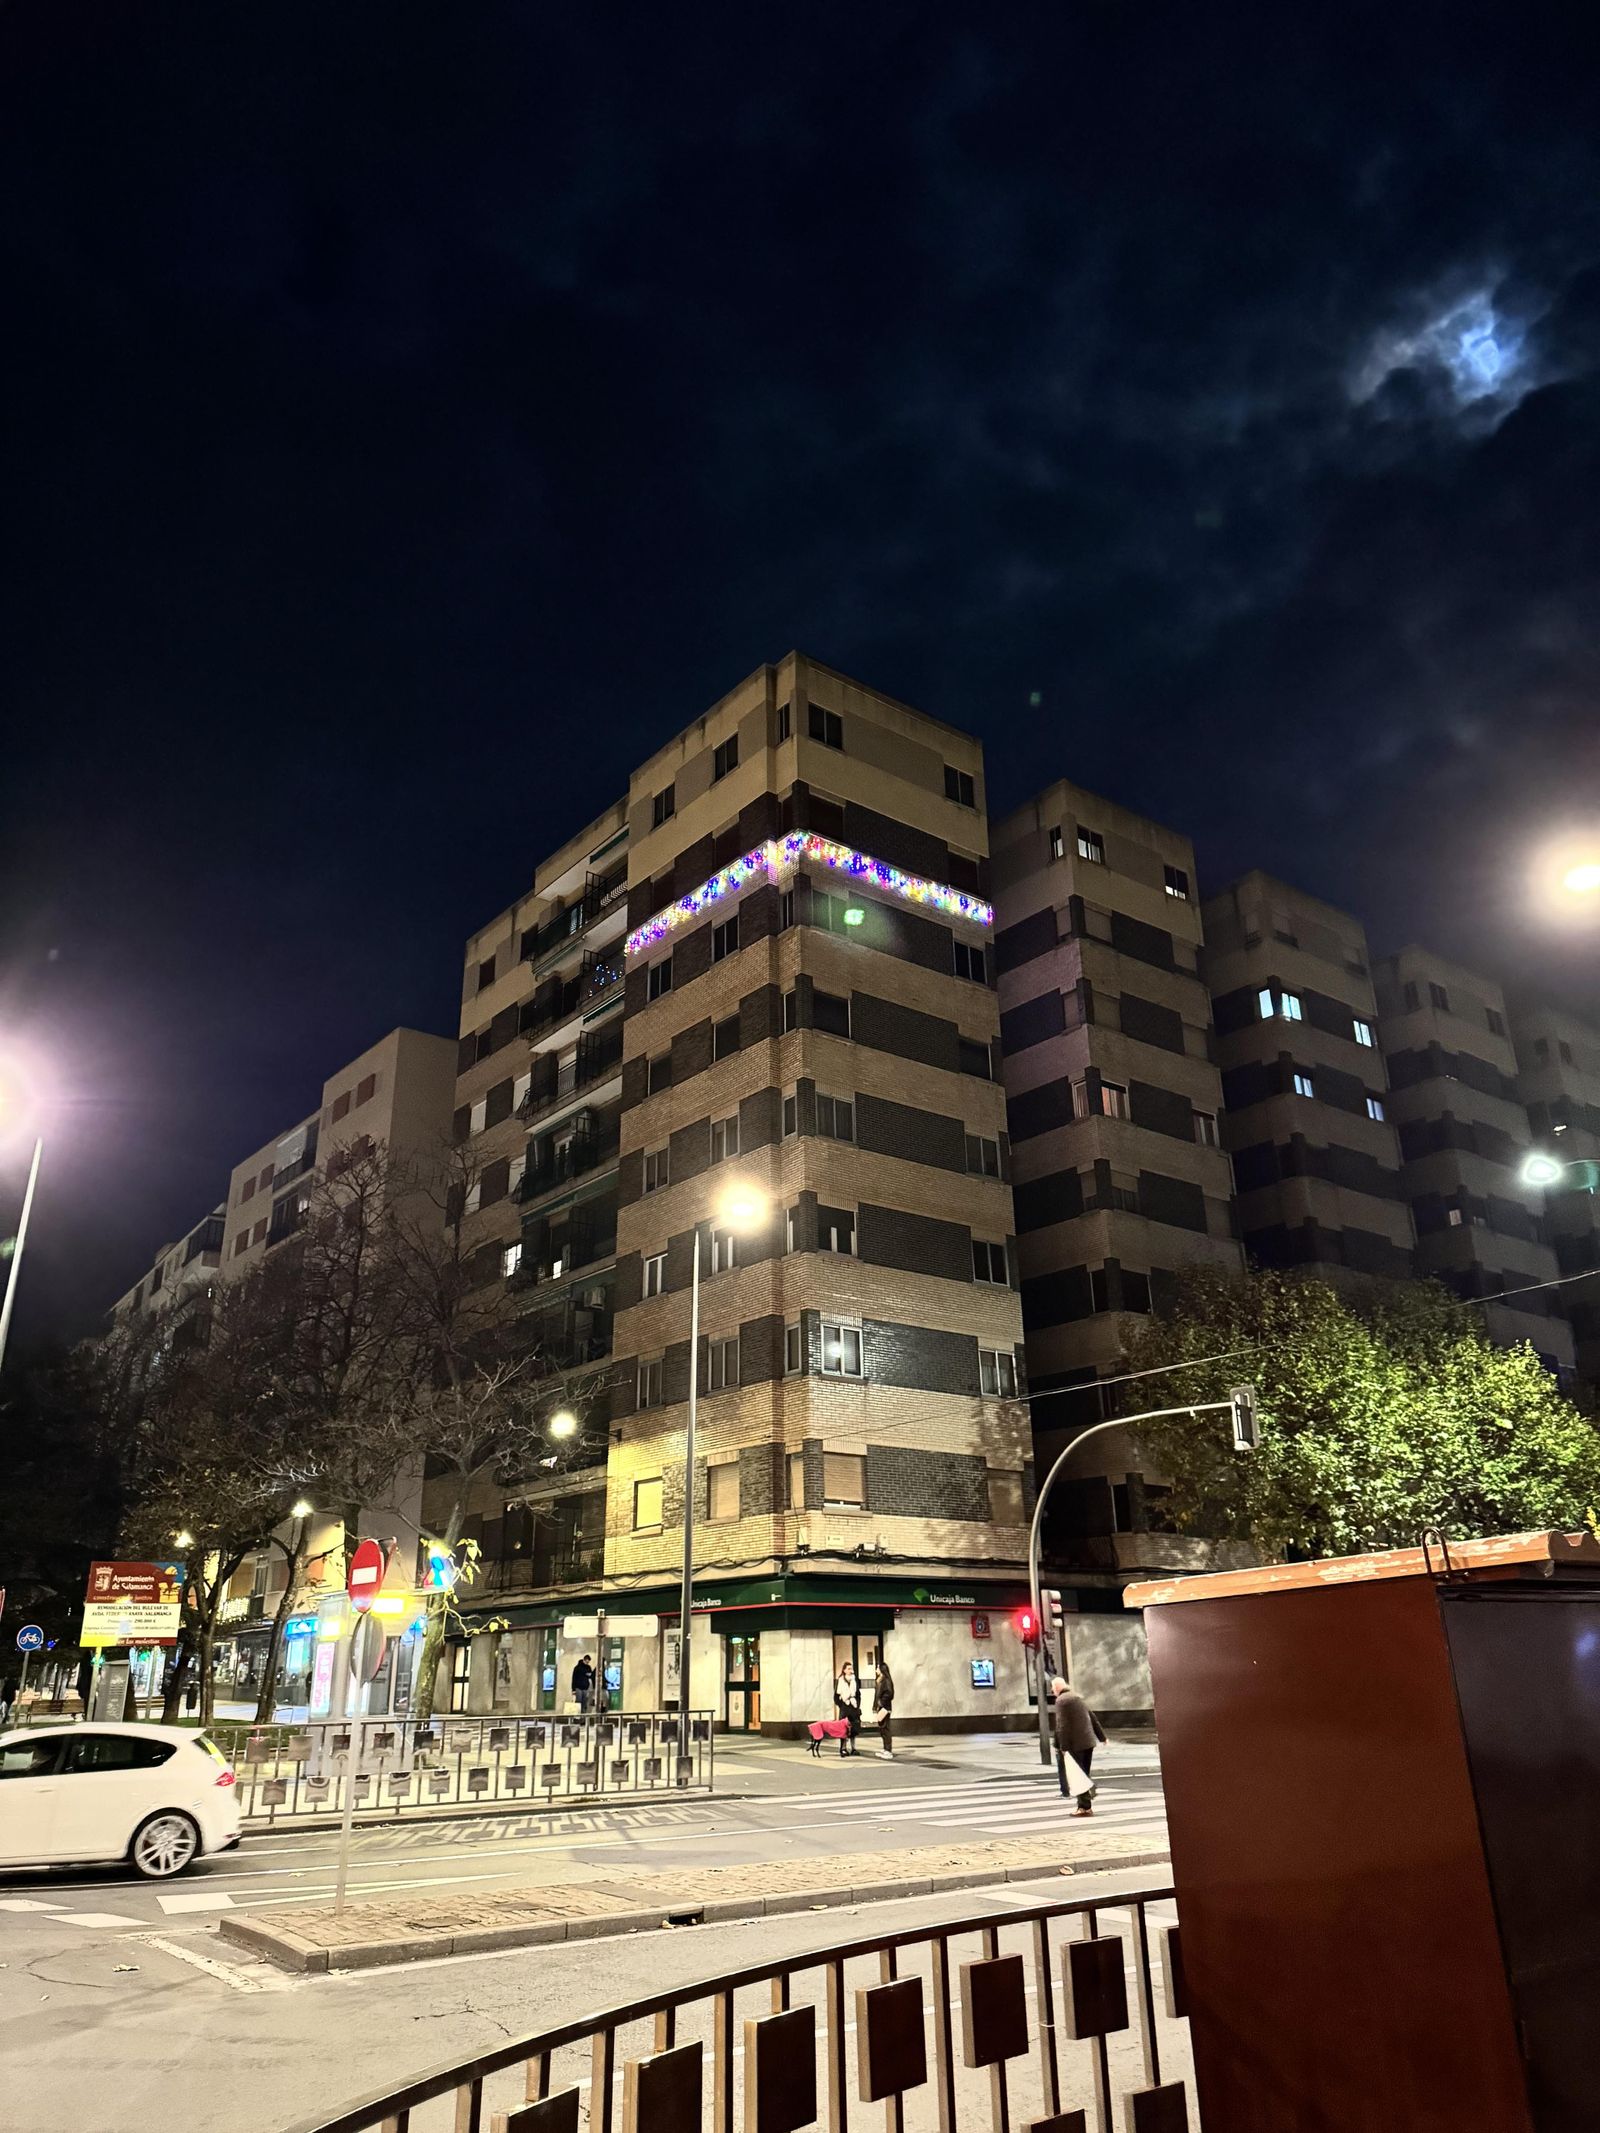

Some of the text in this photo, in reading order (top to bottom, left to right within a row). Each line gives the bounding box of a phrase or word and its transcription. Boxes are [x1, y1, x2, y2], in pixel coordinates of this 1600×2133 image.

[112, 1575, 155, 1583] Ayuntamiento
[930, 1594, 975, 1605] Unicaja Banco
